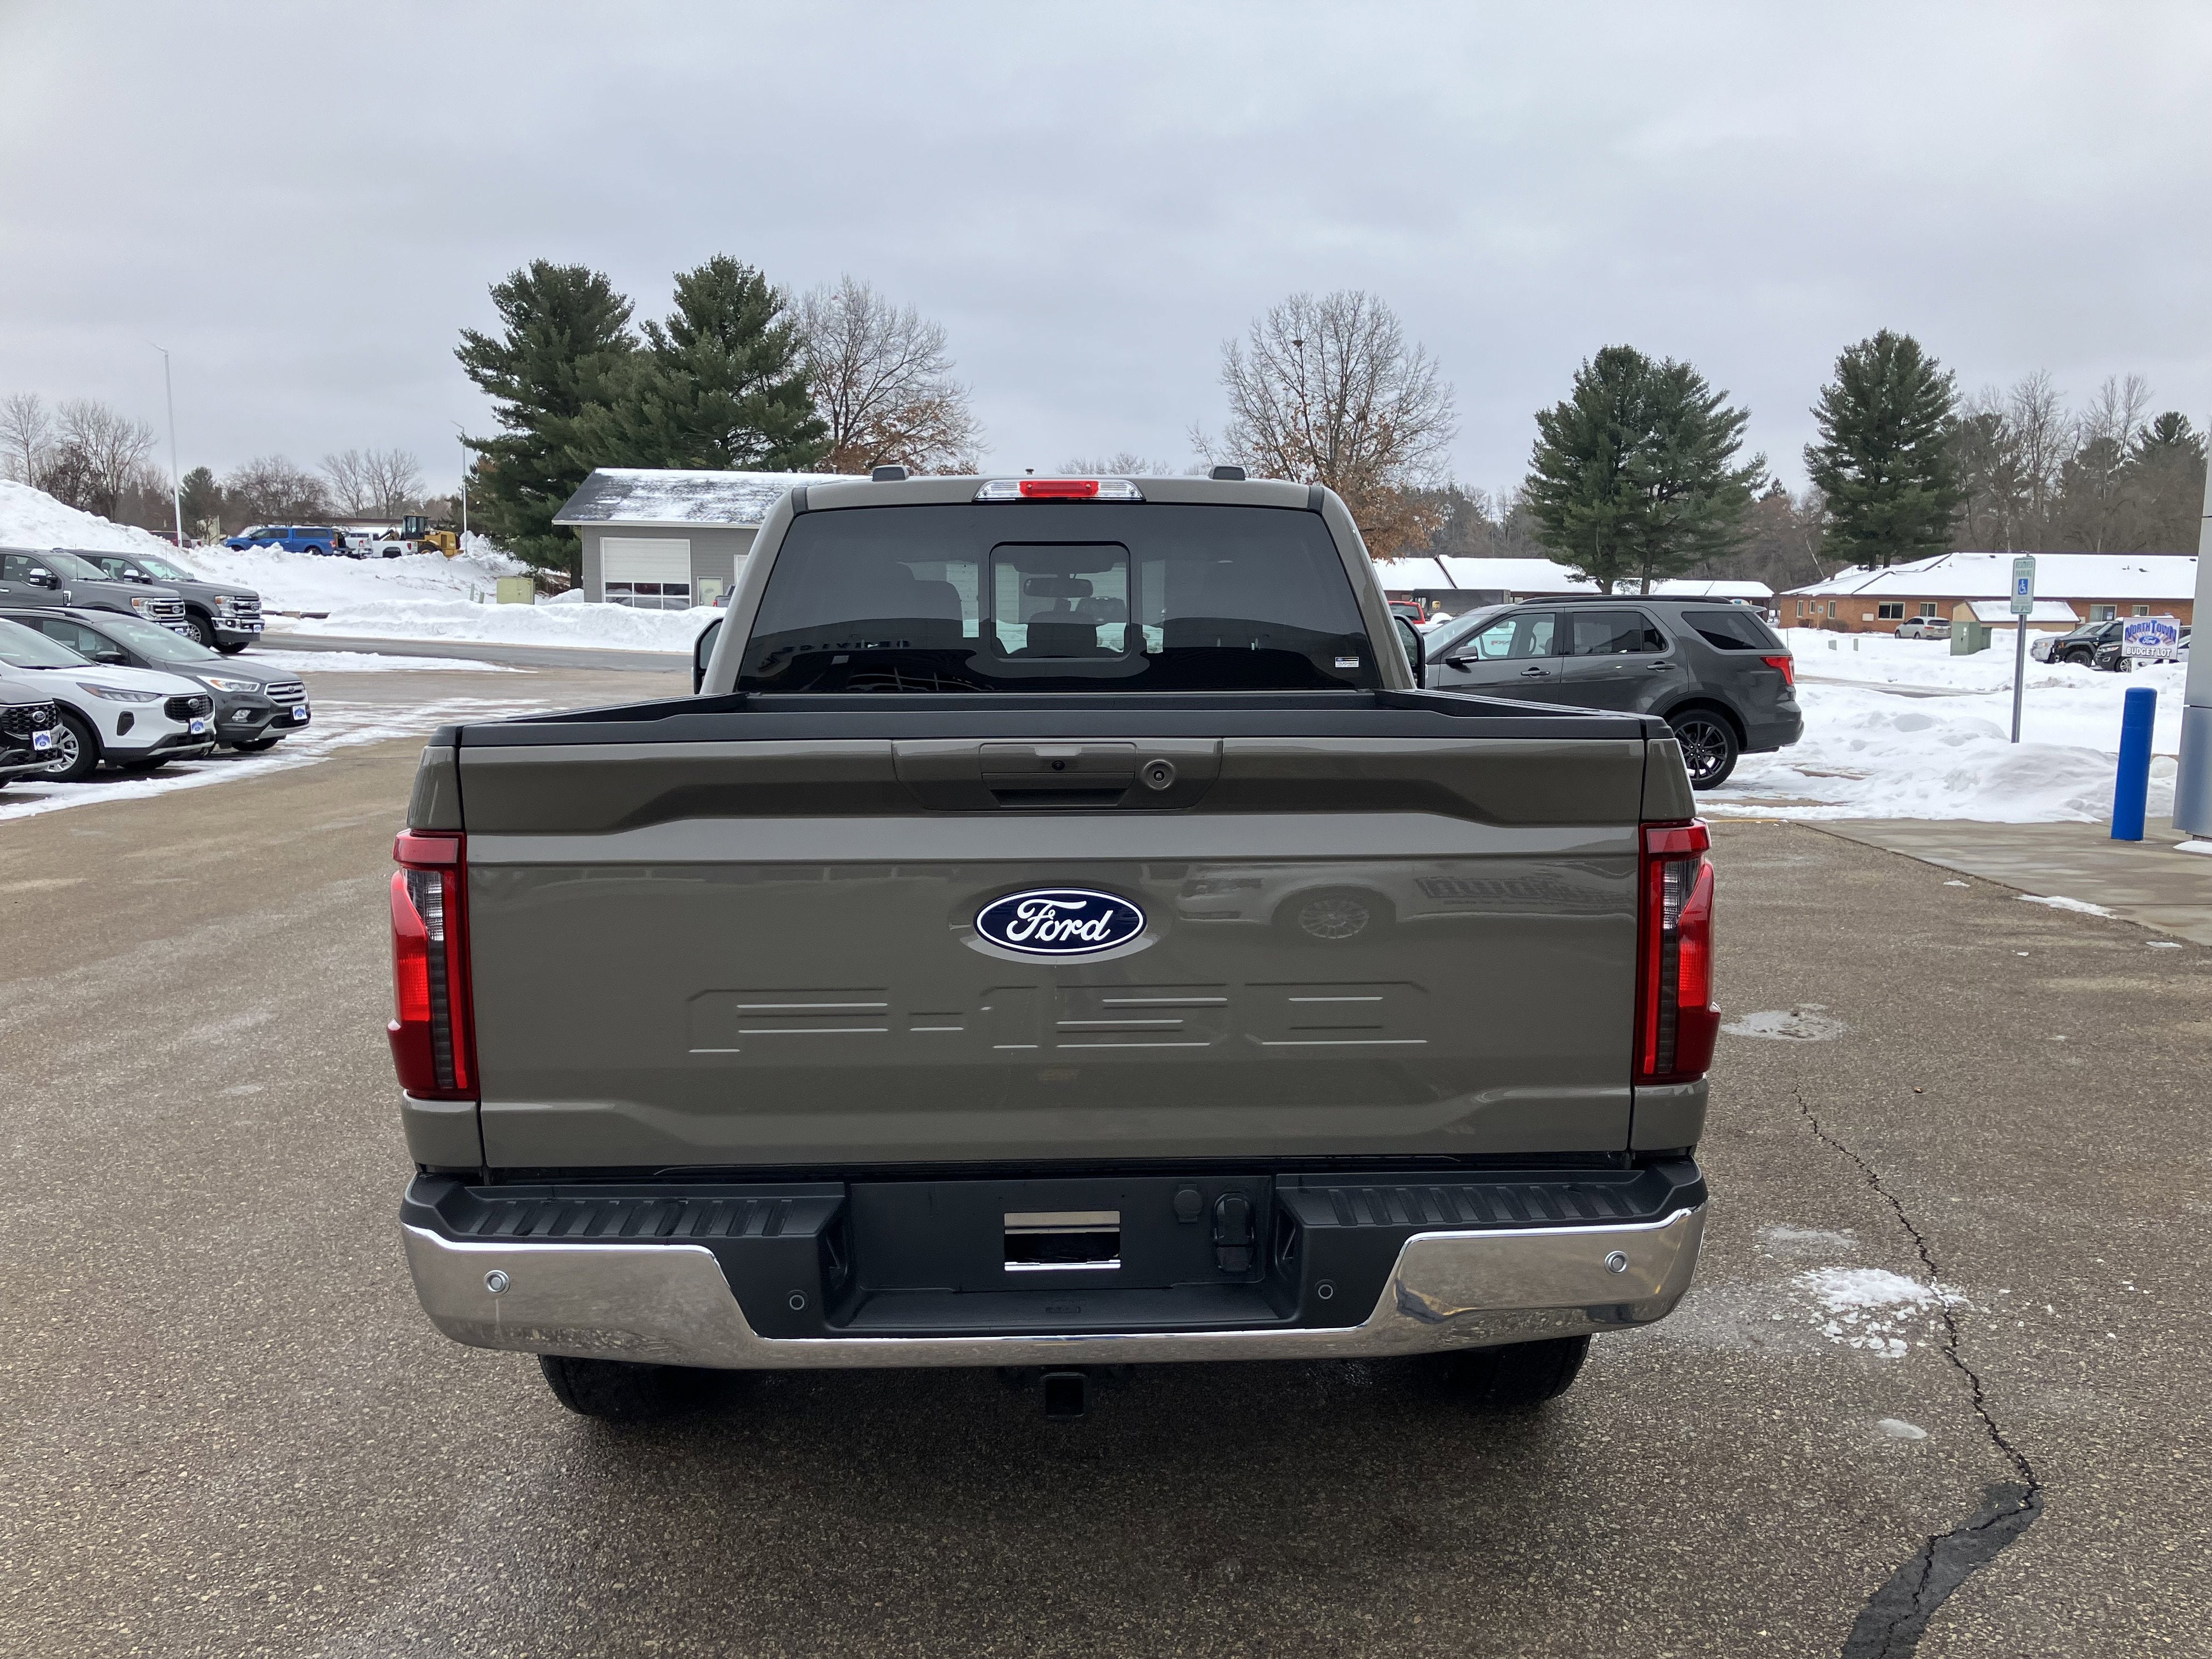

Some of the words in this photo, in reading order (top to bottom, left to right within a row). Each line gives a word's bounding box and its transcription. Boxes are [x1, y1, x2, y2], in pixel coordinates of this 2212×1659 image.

[2142, 636, 2157, 645] Ford
[2126, 647, 2155, 656] BUDGET
[2157, 648, 2171, 657] LOT
[1006, 899, 1114, 941] Ford
